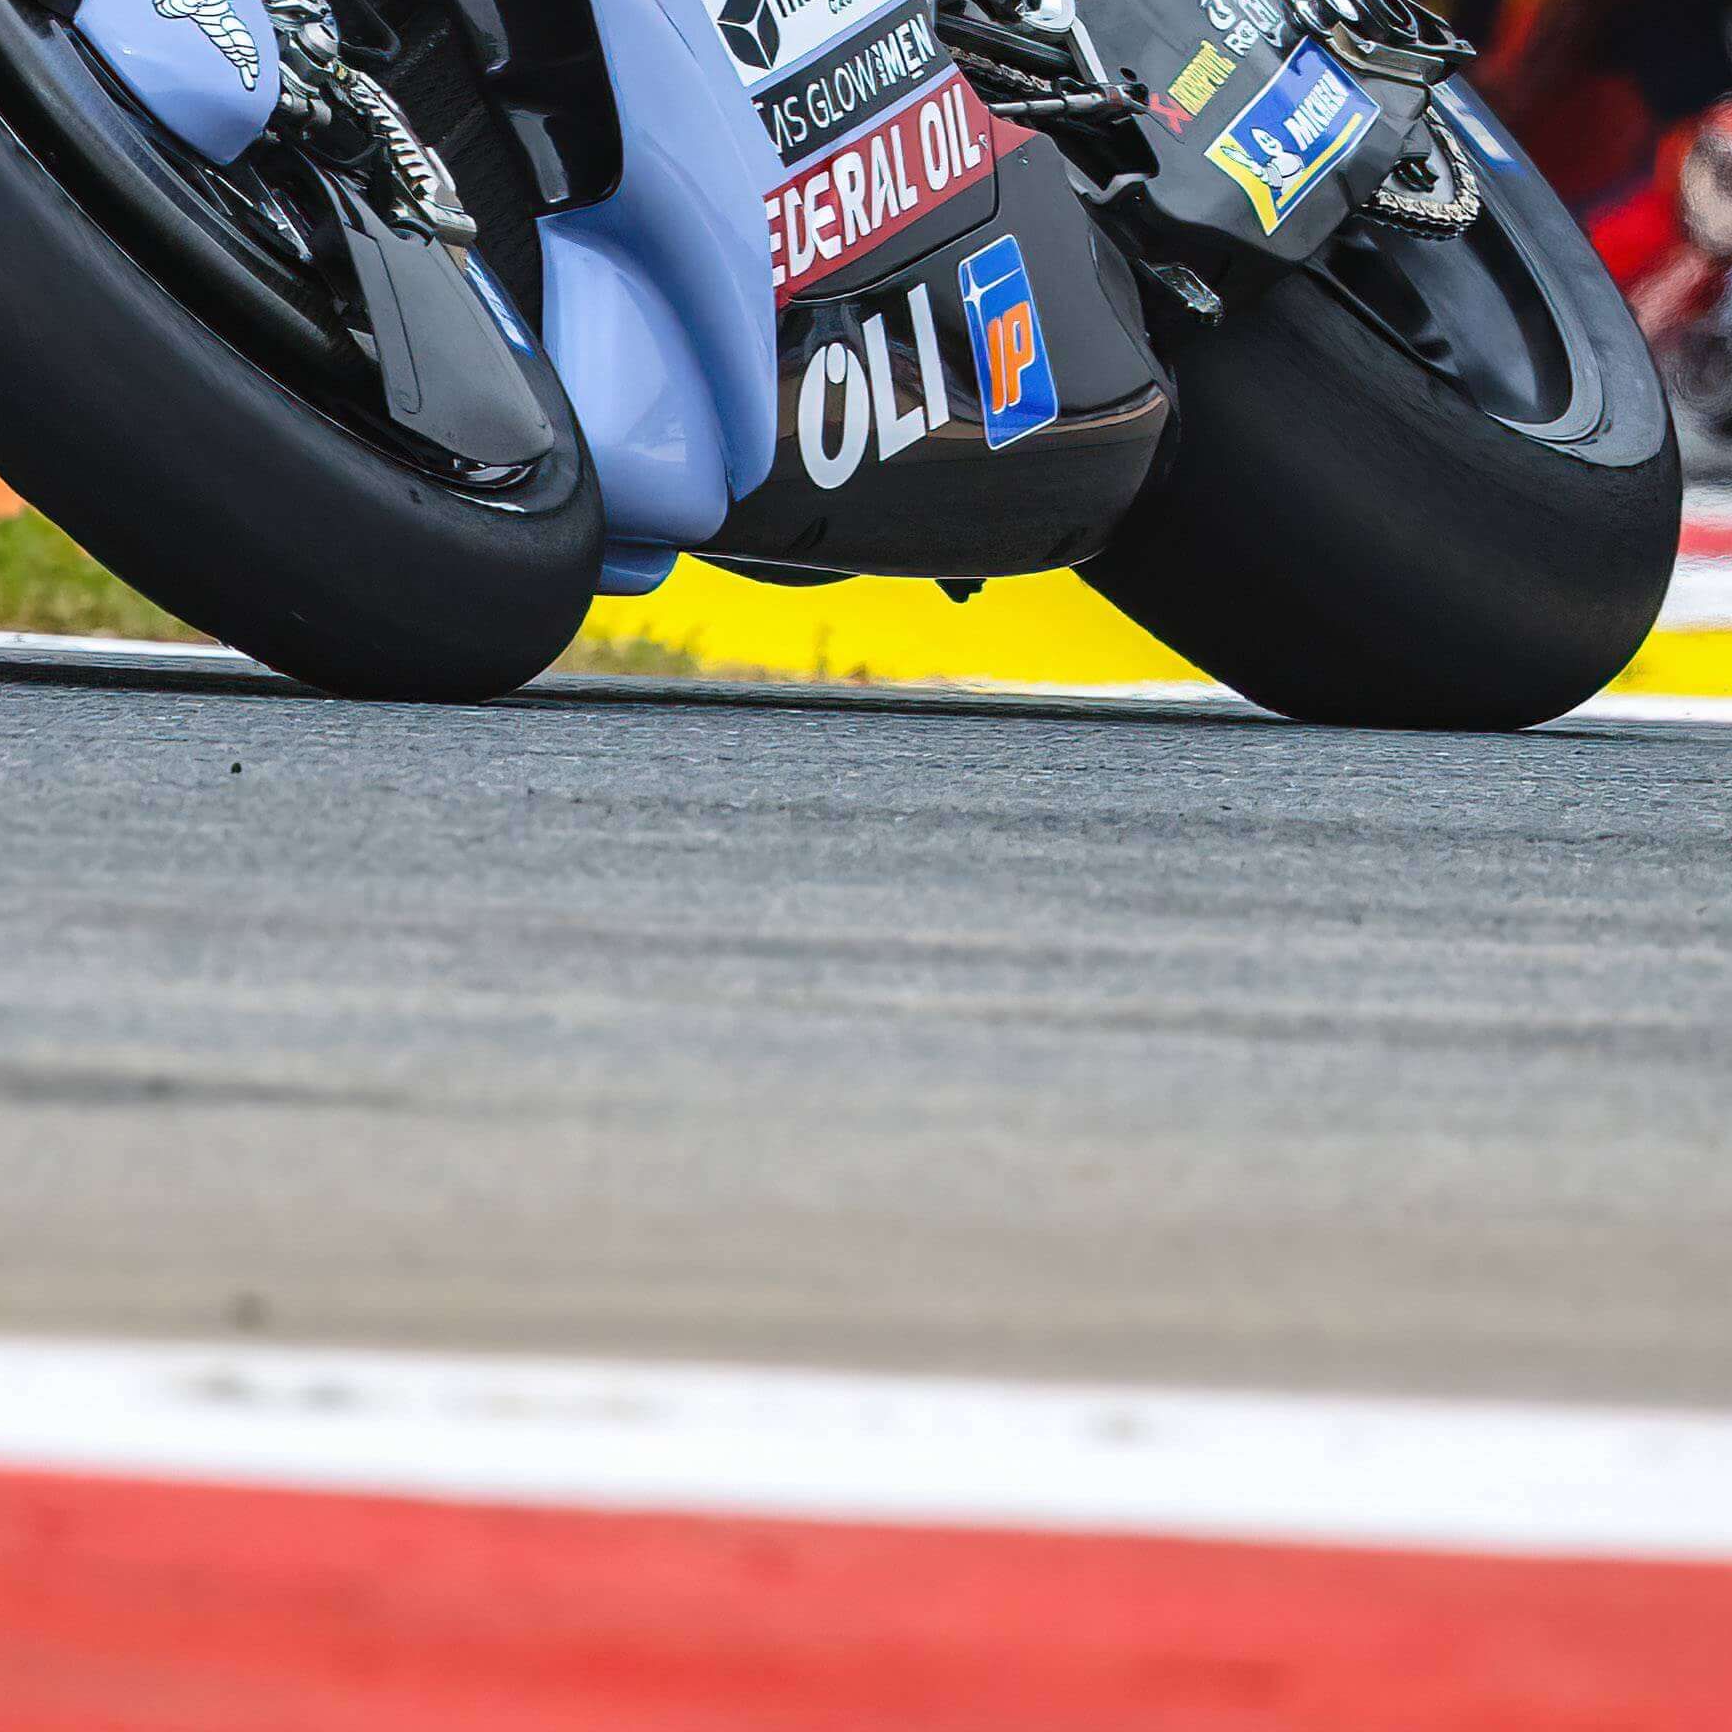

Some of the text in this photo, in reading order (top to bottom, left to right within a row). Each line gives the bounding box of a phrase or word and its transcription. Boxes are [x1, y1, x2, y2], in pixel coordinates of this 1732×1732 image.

[806, 47, 877, 128] GLOW
[878, 13, 936, 84] MEN
[765, 83, 982, 287] EDERAL OIL
[797, 282, 950, 491] OLI
[987, 300, 1037, 415] IP
